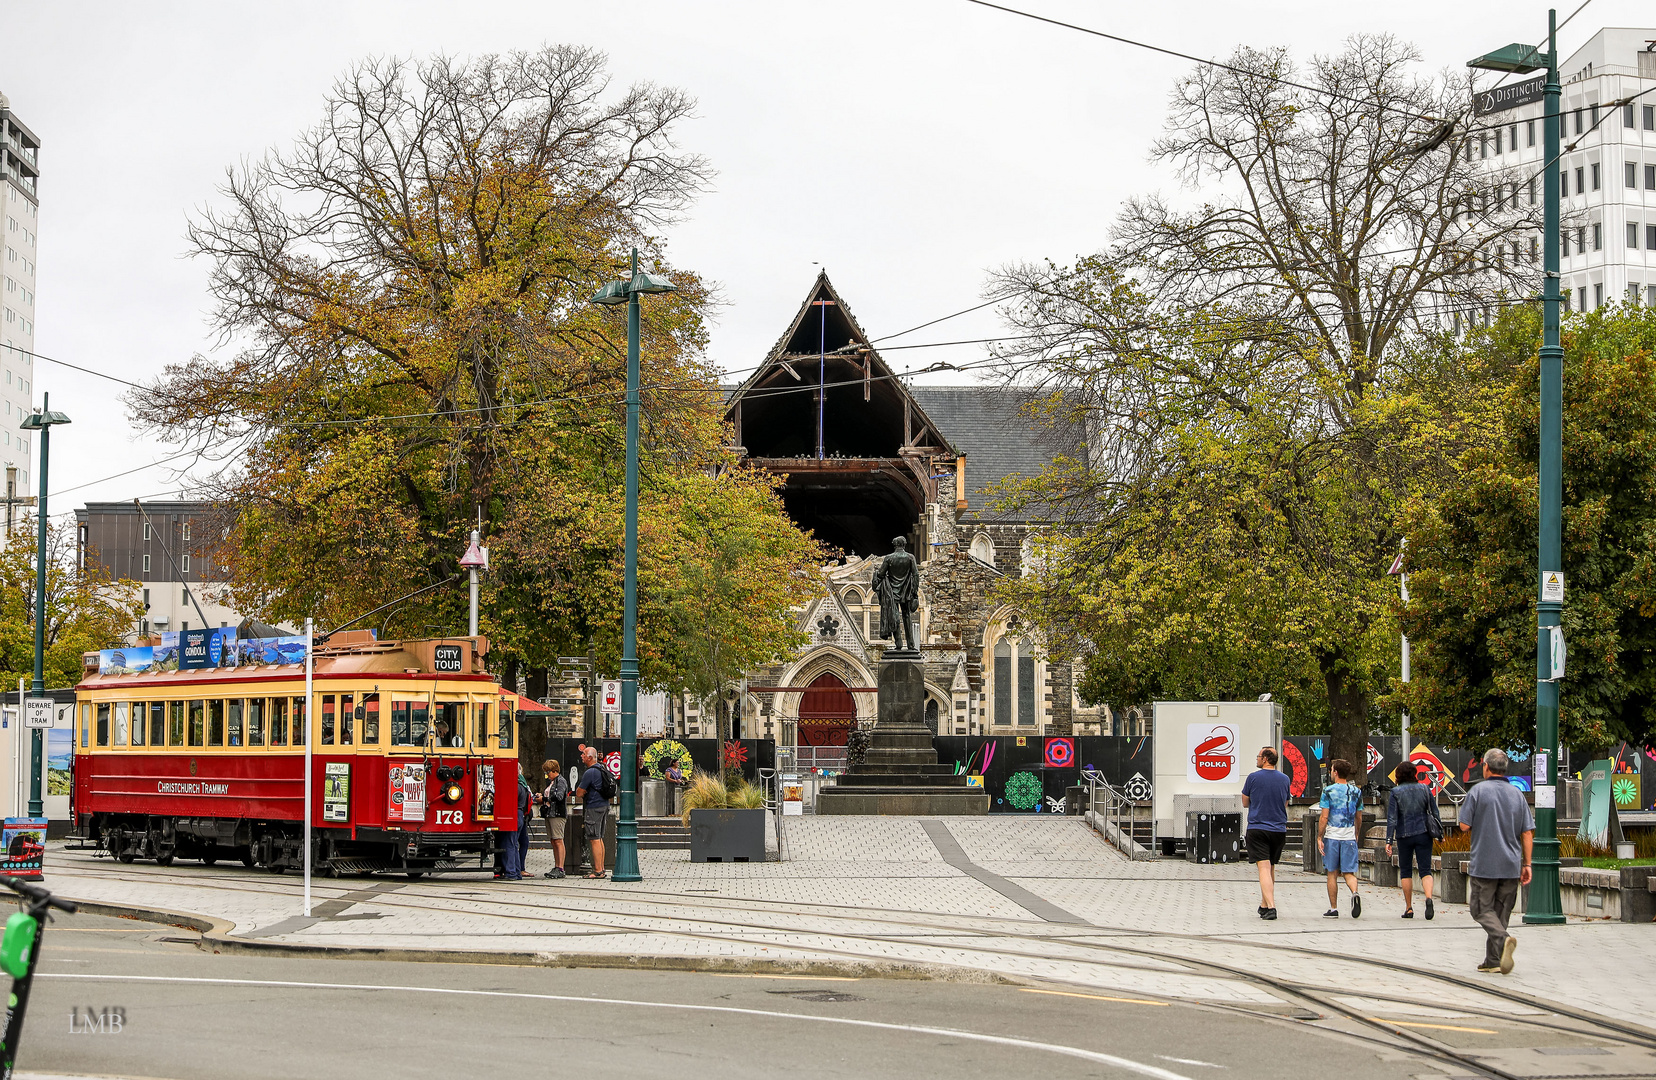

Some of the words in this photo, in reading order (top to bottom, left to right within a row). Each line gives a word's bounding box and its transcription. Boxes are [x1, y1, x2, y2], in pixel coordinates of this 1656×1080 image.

[1496, 79, 1546, 103] DISTINCTIO
[436, 649, 459, 660] CITY
[434, 659, 462, 671] TOUR
[35, 709, 44, 717] OF
[404, 782, 425, 792] QUAKE
[407, 791, 422, 802] CITY
[435, 809, 464, 825] 178
